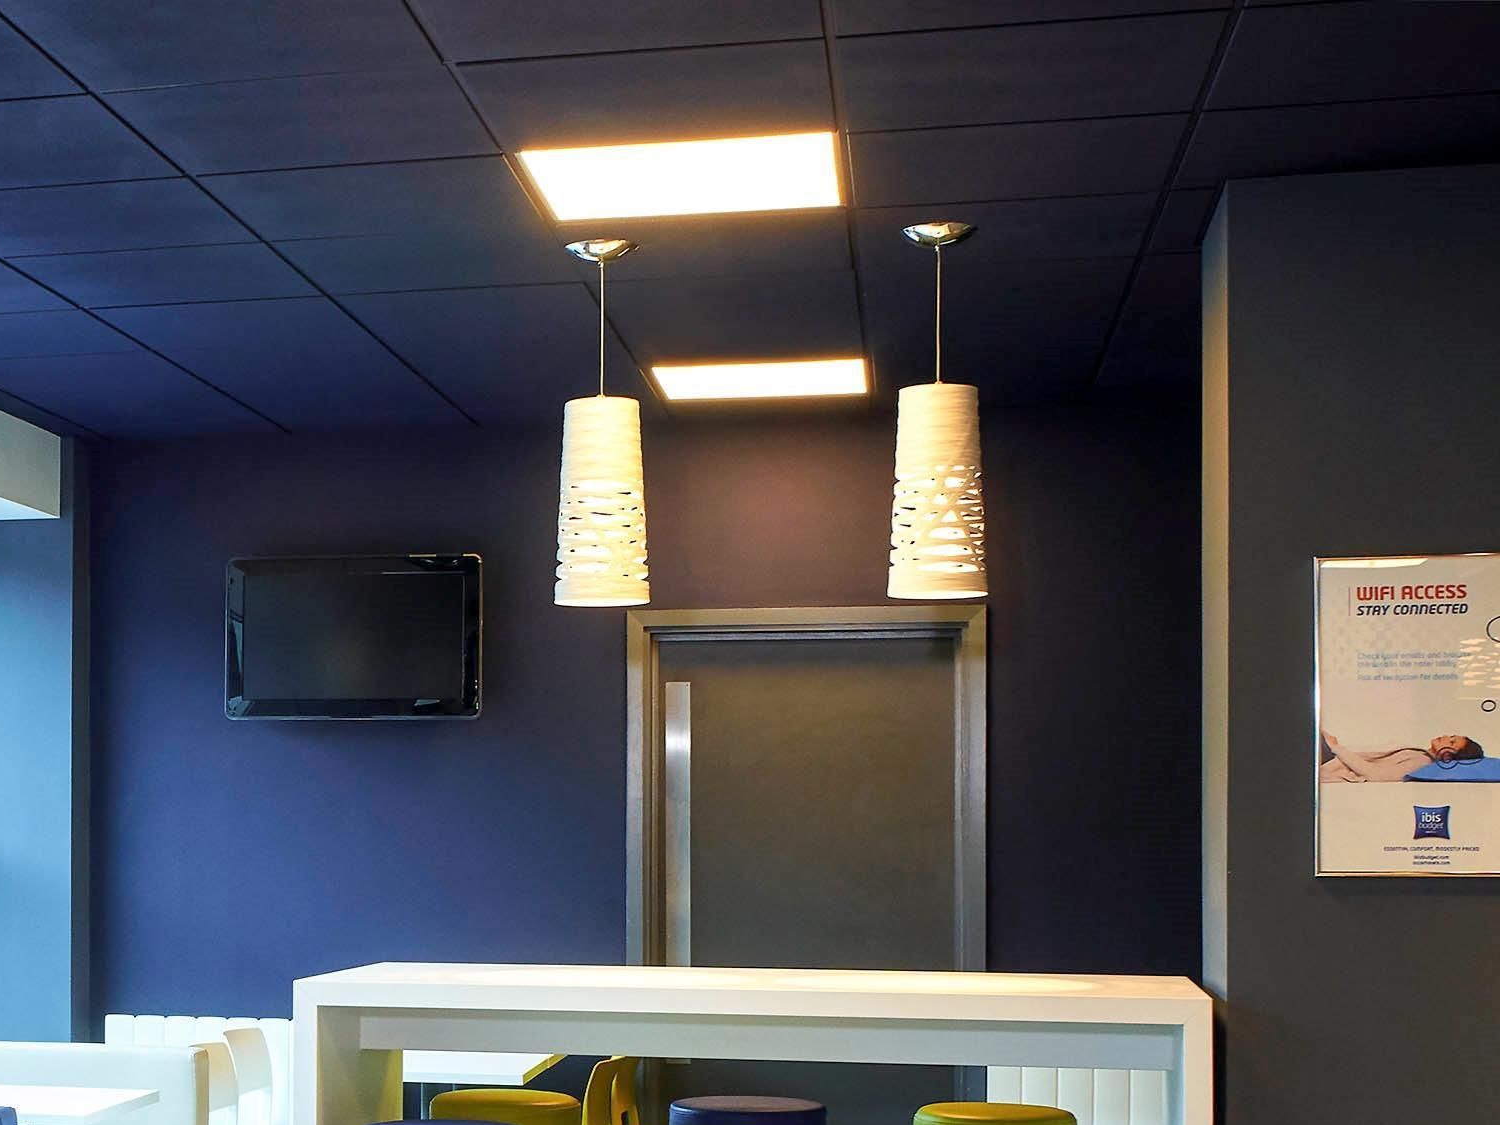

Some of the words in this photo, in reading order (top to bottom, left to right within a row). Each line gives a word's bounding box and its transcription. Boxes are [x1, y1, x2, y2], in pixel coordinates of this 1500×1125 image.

[1356, 586, 1395, 601] WIFI
[1401, 584, 1467, 600] ACCESS
[1356, 605, 1390, 616] STAY
[1393, 603, 1468, 615] CONNECTED
[1421, 811, 1441, 822] ibis
[1418, 821, 1444, 830] budget
